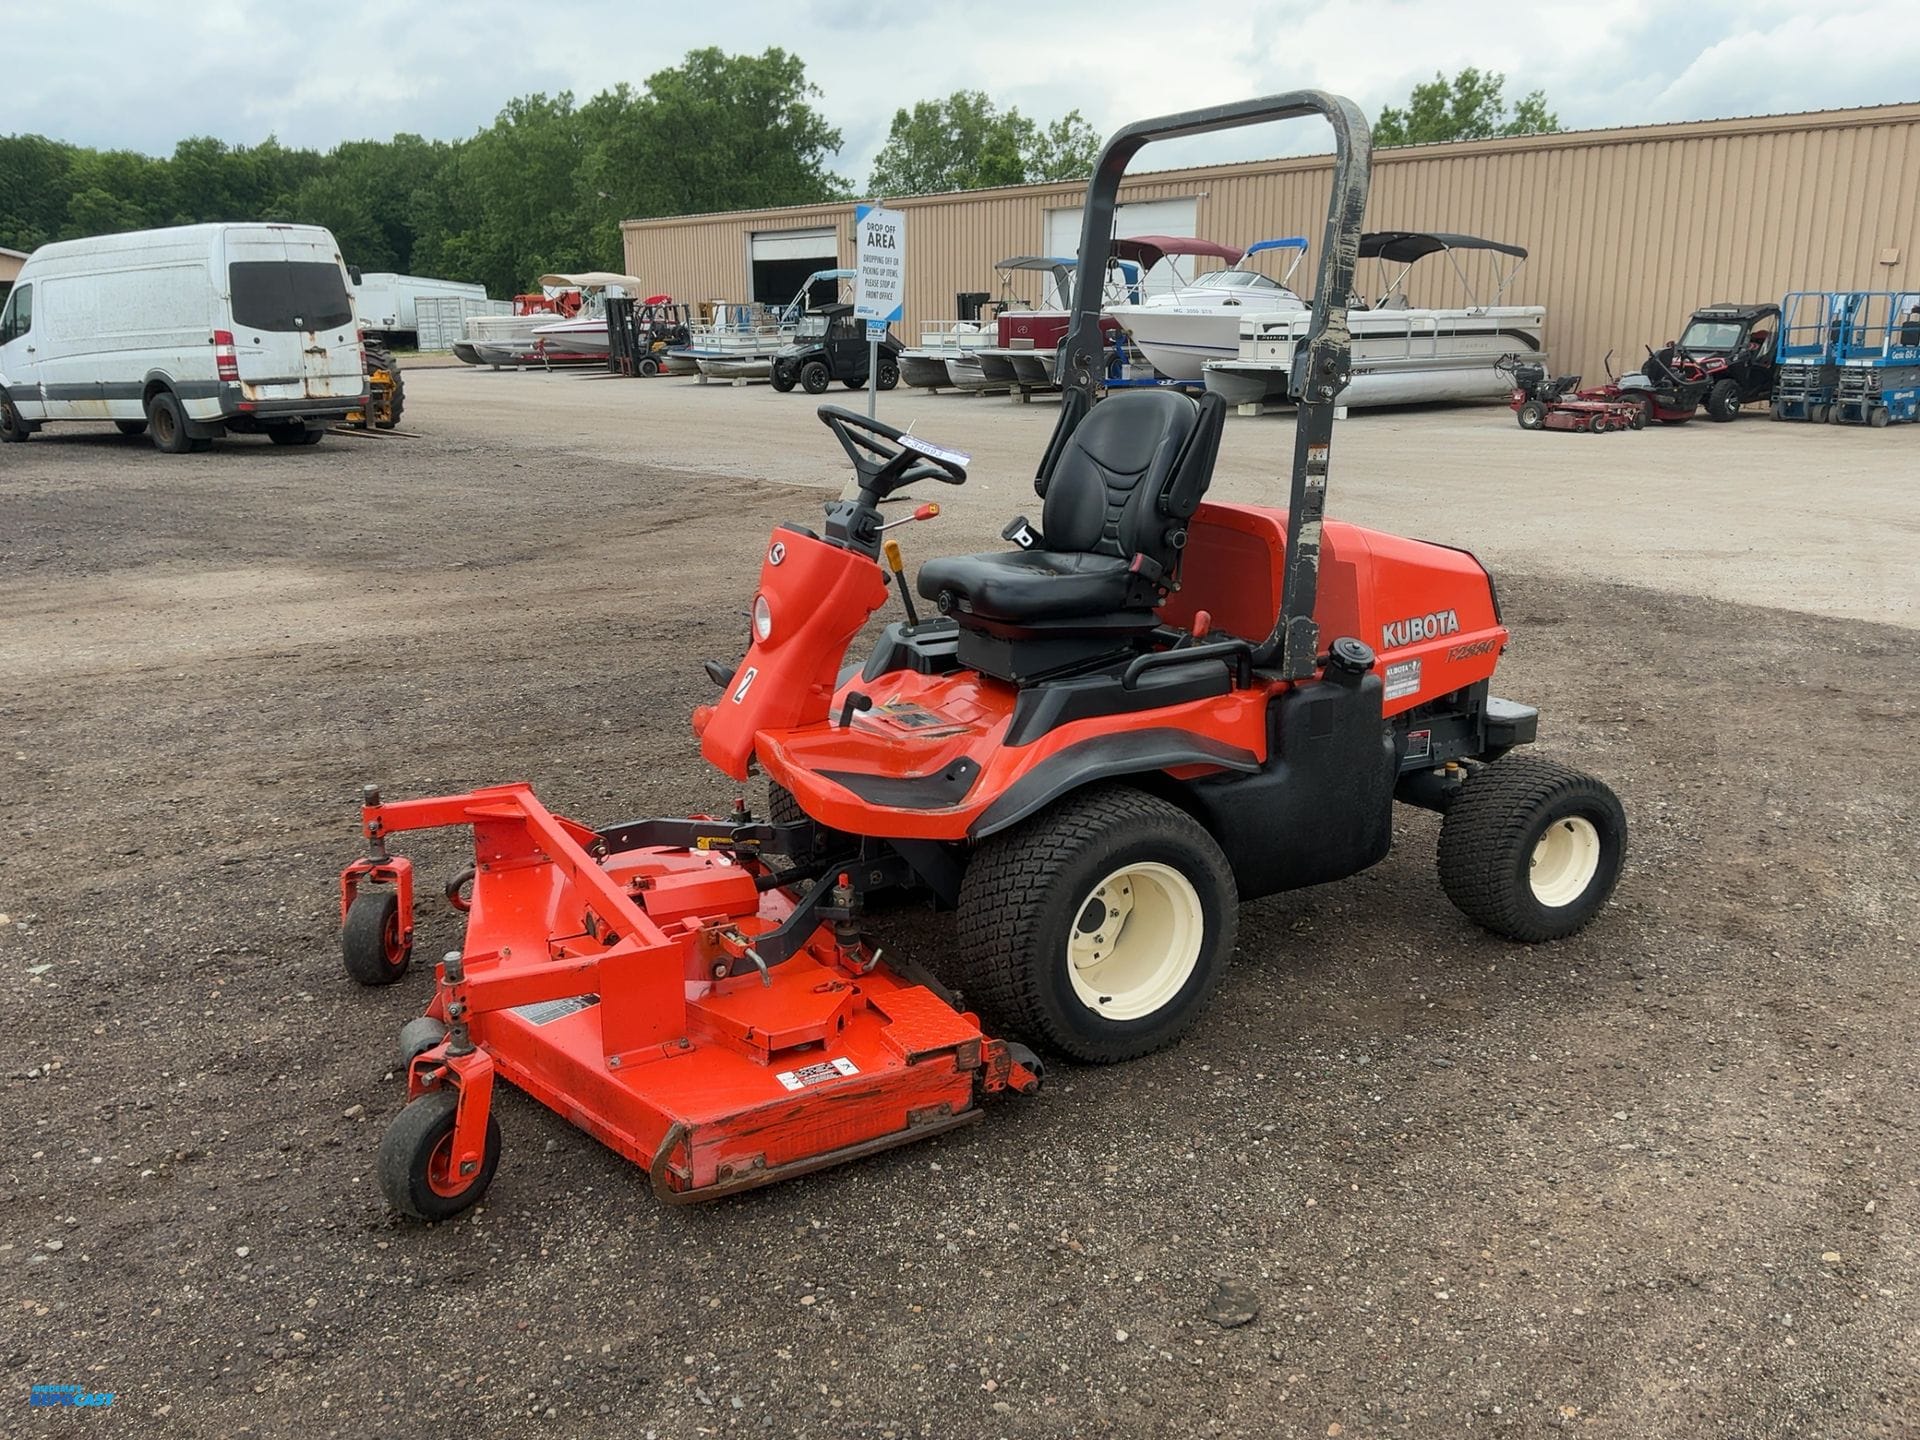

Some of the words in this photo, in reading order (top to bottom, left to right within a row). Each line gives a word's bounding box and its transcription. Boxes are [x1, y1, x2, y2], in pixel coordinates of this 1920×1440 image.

[867, 222, 883, 233] DROP
[885, 225, 896, 234] OFF
[867, 232, 896, 249] AREA
[864, 254, 884, 264] DROPPING
[885, 256, 893, 265] OFF
[893, 257, 899, 266] OR
[863, 266, 879, 275] PICKING
[880, 268, 886, 277] UP
[865, 279, 879, 287] PLEASE
[880, 280, 891, 289] STOP
[891, 281, 896, 289] AT
[866, 291, 879, 299] FRONT
[879, 291, 893, 300] OFFICE
[1382, 609, 1459, 649] KUBOTA
[734, 670, 755, 702] 2
